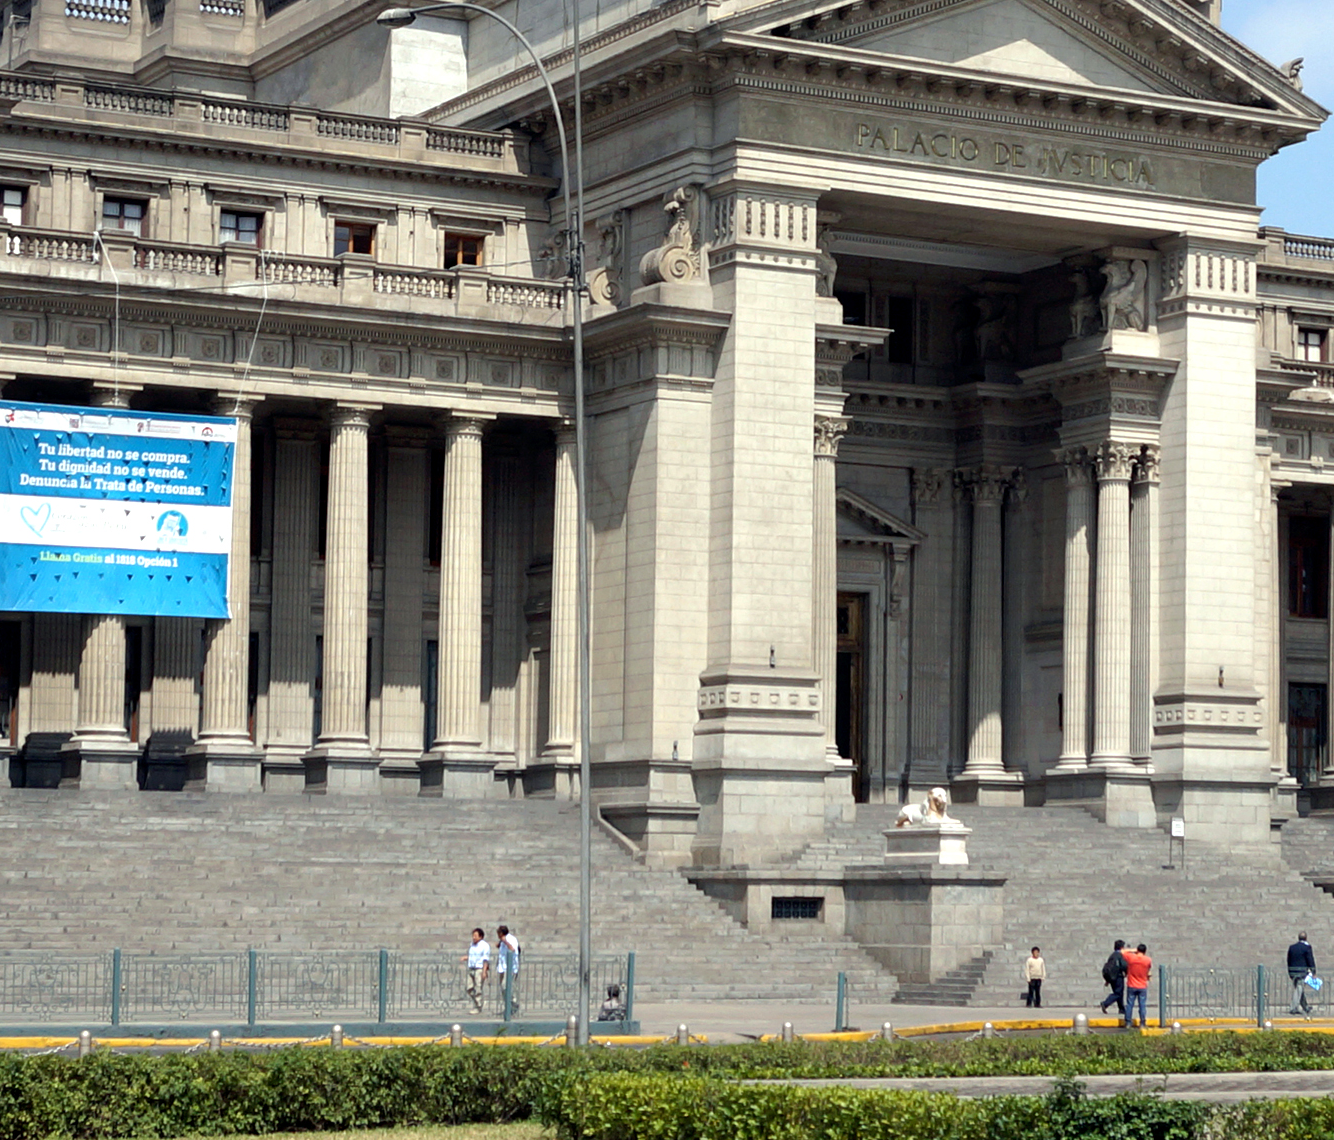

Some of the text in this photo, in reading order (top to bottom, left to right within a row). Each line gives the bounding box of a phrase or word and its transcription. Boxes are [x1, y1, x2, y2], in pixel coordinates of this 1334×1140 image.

[857, 122, 980, 162] PALACIO
[994, 141, 1026, 168] DE
[39, 443, 191, 464] Tu libertad no se compra.
[39, 459, 188, 479] Tu dignidad no se vende.
[20, 474, 205, 496] Denuncia la Trata de Personas.
[73, 553, 103, 563] Gratis
[104, 554, 115, 564] al
[137, 556, 172, 568] Opción
[172, 557, 178, 567] 1
